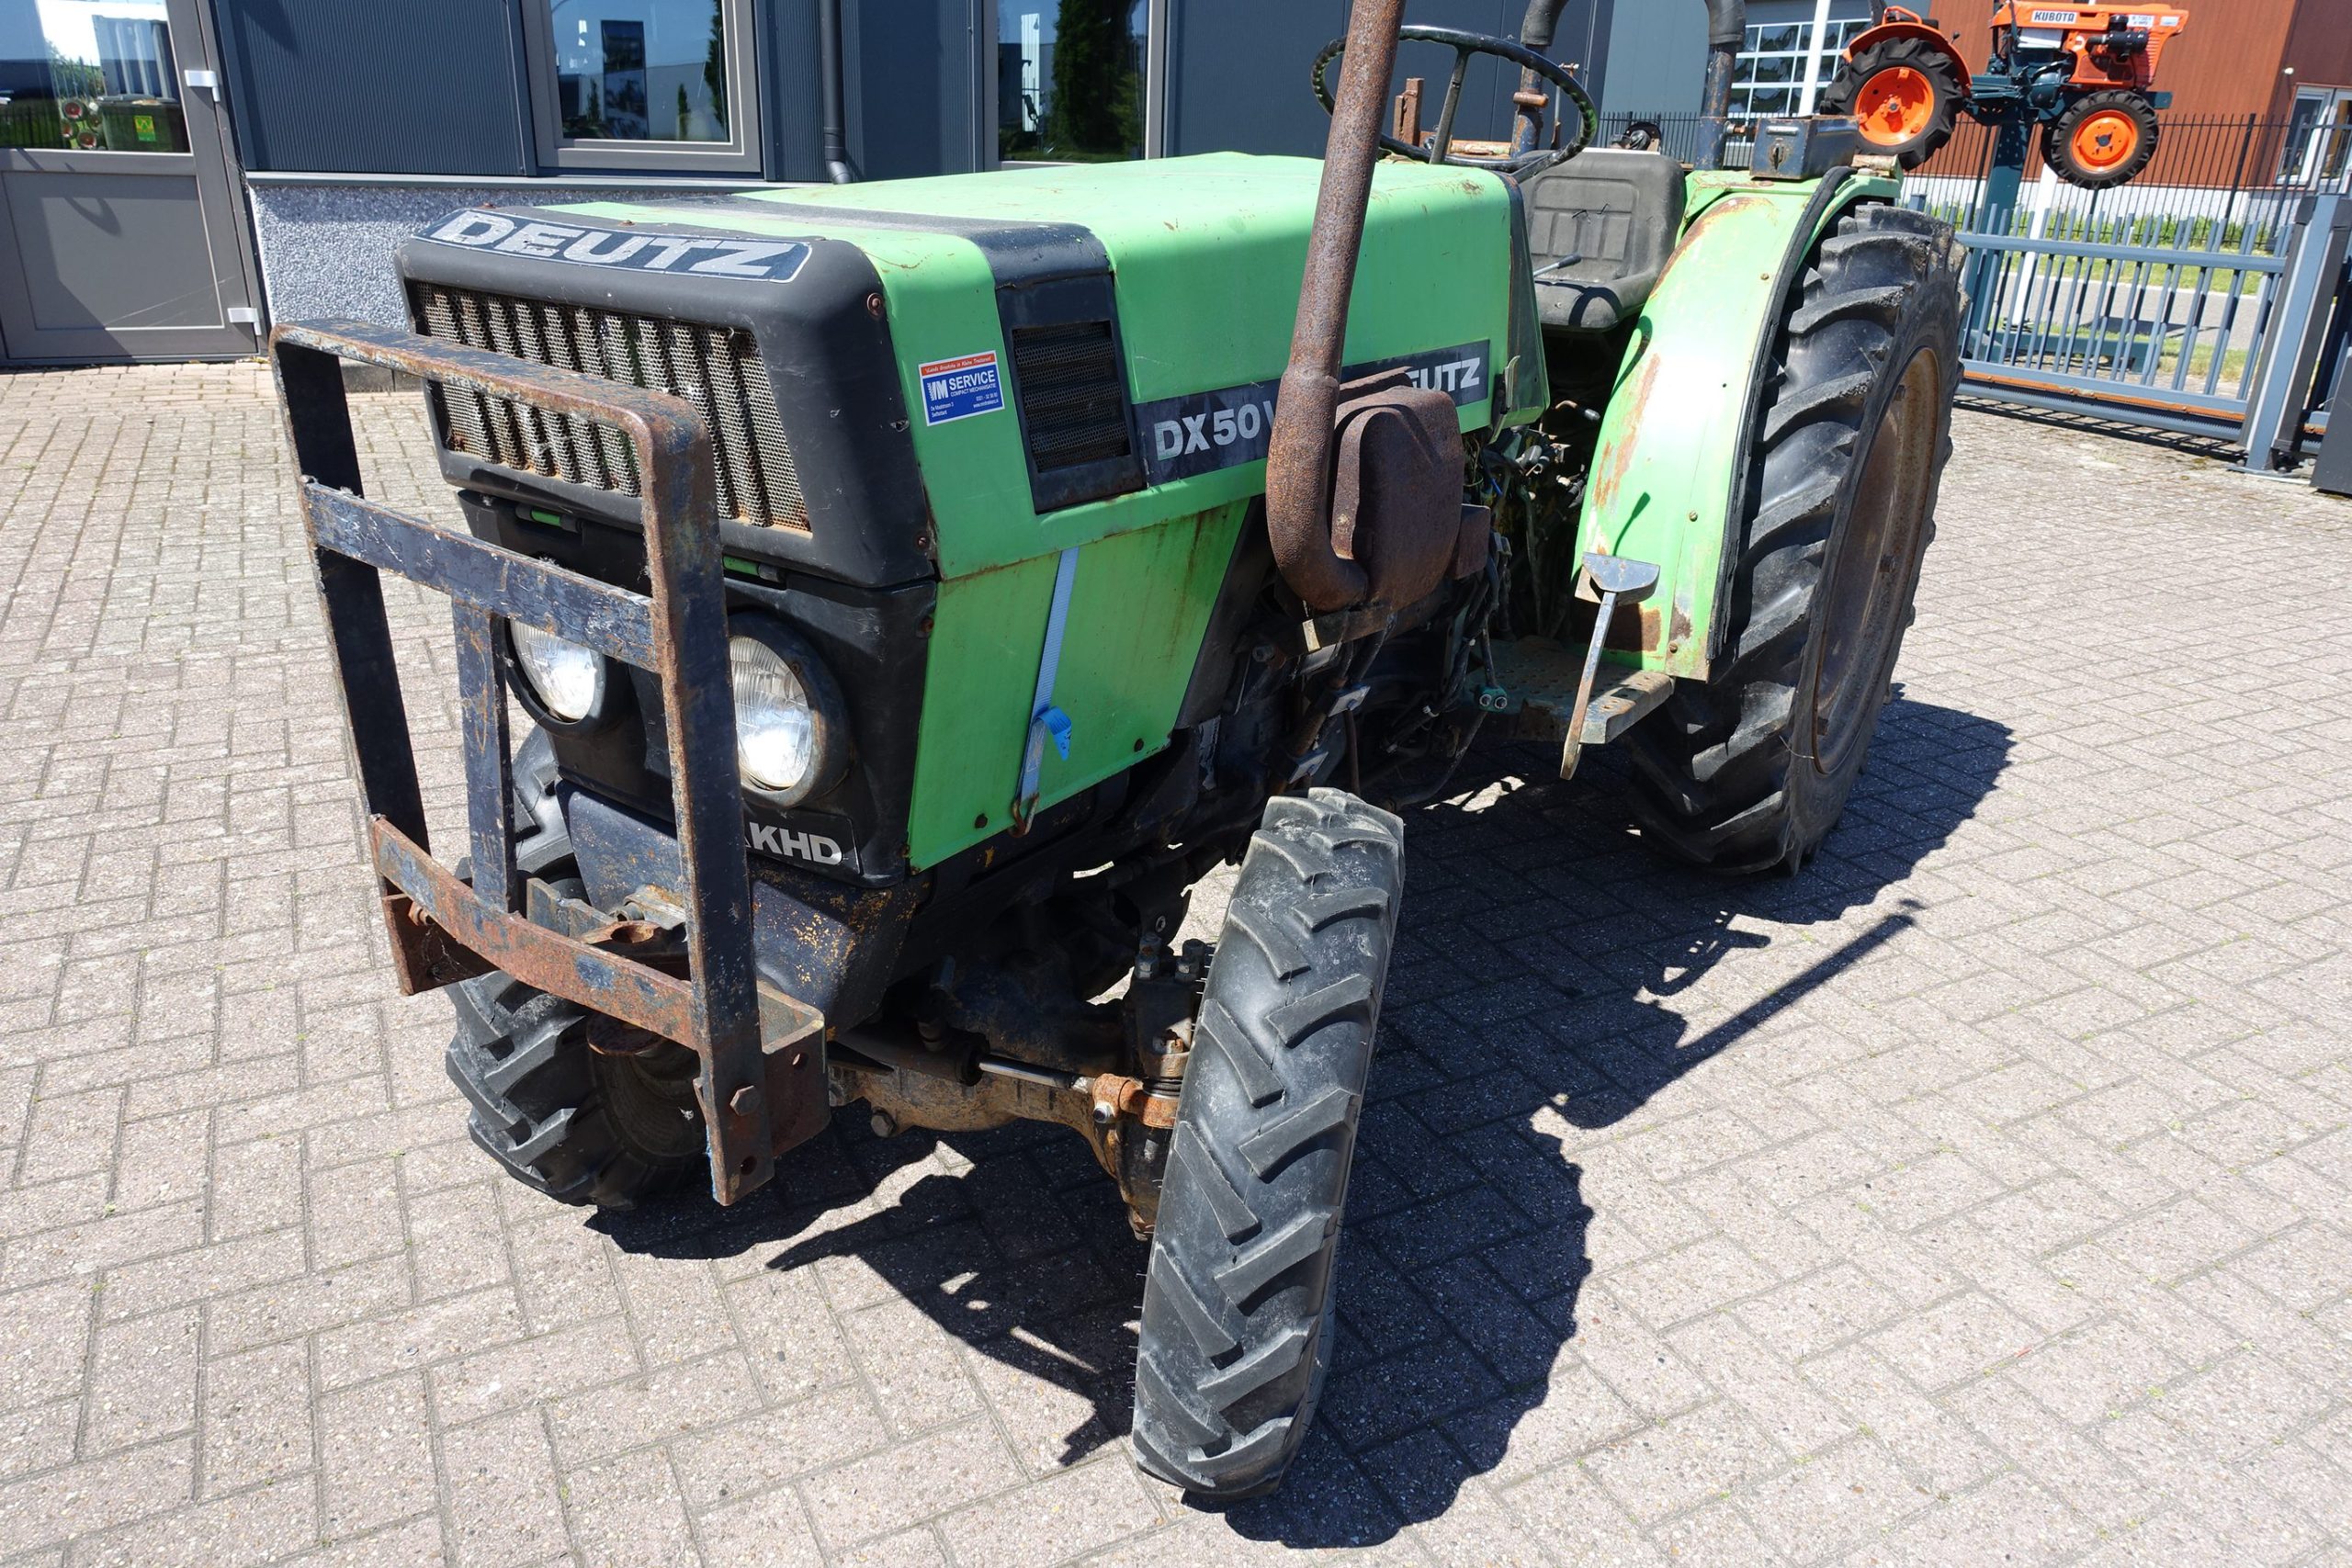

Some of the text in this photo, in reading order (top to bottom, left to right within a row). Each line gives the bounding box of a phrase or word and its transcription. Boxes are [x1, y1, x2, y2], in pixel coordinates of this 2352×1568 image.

[2034, 11, 2075, 22] KUBOTA
[431, 209, 797, 277] DEUTZ
[949, 370, 995, 390] SERVICE
[950, 388, 969, 397] COMPACT
[750, 821, 842, 865] KHD
